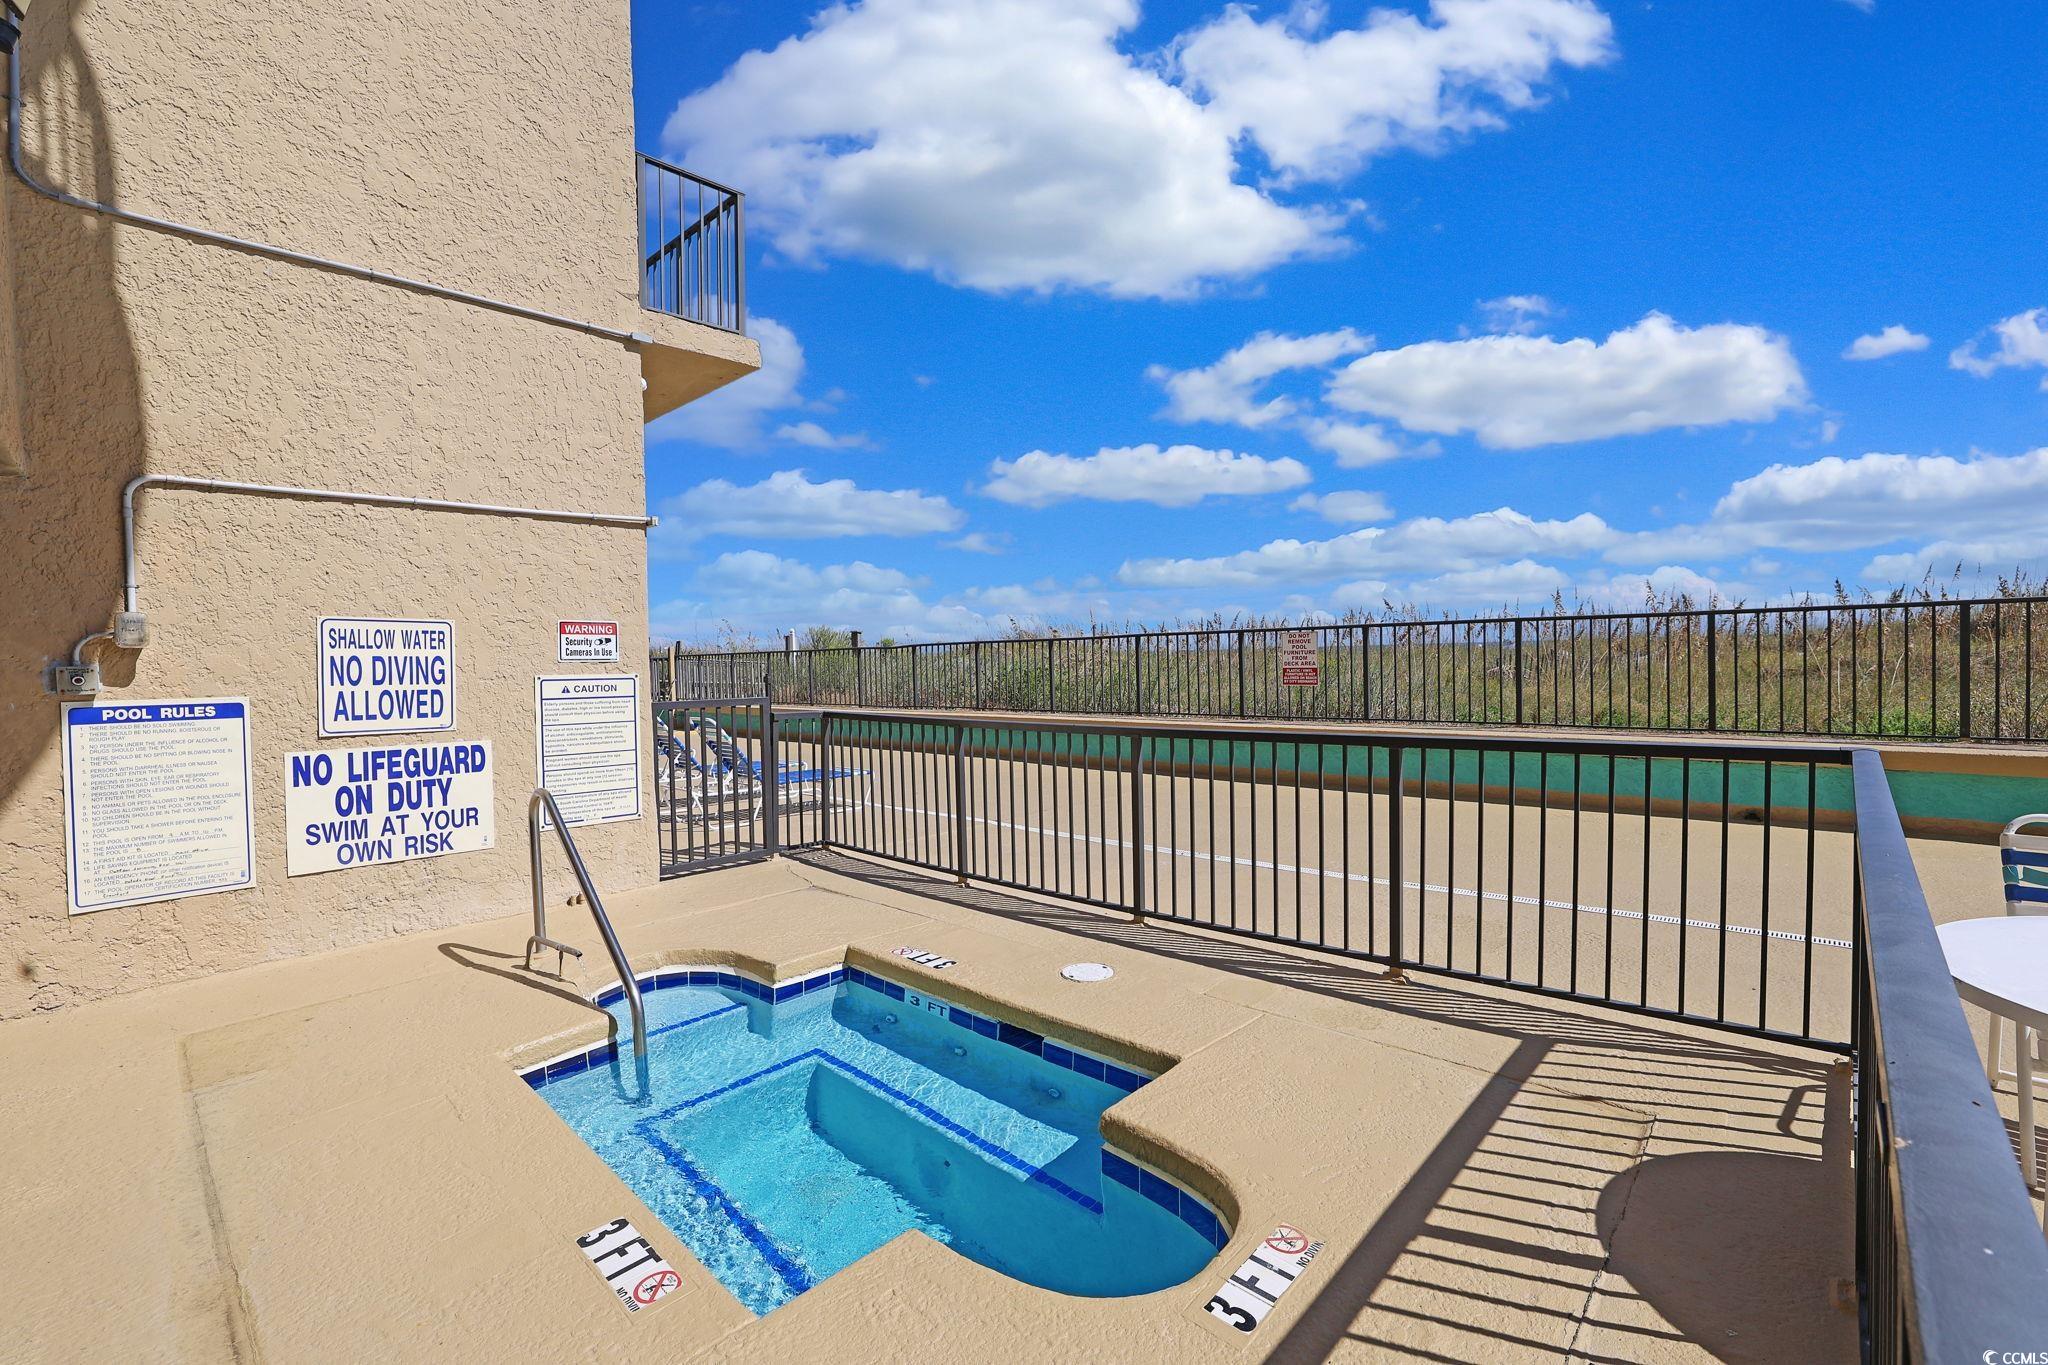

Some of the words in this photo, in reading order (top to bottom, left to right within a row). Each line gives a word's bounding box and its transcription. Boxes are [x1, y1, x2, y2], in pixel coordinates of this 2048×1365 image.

[328, 628, 395, 650] SHALLOW
[402, 630, 445, 650] WATER
[565, 625, 613, 634] WARNING
[566, 637, 592, 647] Security
[566, 648, 592, 657] Cameras
[594, 648, 600, 656] In
[601, 648, 612, 656] Use
[330, 656, 362, 686] NO
[372, 656, 446, 686] DIVING
[573, 684, 617, 693] CAUTION
[102, 708, 152, 721] POOL
[160, 706, 216, 718] RULES
[334, 689, 444, 722] ALLOWED
[292, 754, 332, 787] NO
[348, 744, 486, 783] LIFEGUARD
[335, 784, 373, 817] ON
[388, 777, 452, 811] DUTY
[305, 818, 369, 846] SWIM
[380, 814, 409, 836] AT
[421, 807, 479, 831] YOUR
[337, 840, 392, 865] OWN
[405, 831, 454, 856] RISK
[907, 953, 942, 964] FT
[910, 996, 920, 1006] 3
[928, 1002, 946, 1016] FT
[576, 1218, 629, 1248] 3
[593, 1236, 663, 1281] FT
[1296, 1257, 1311, 1268] NO
[1204, 1295, 1257, 1332] 3
